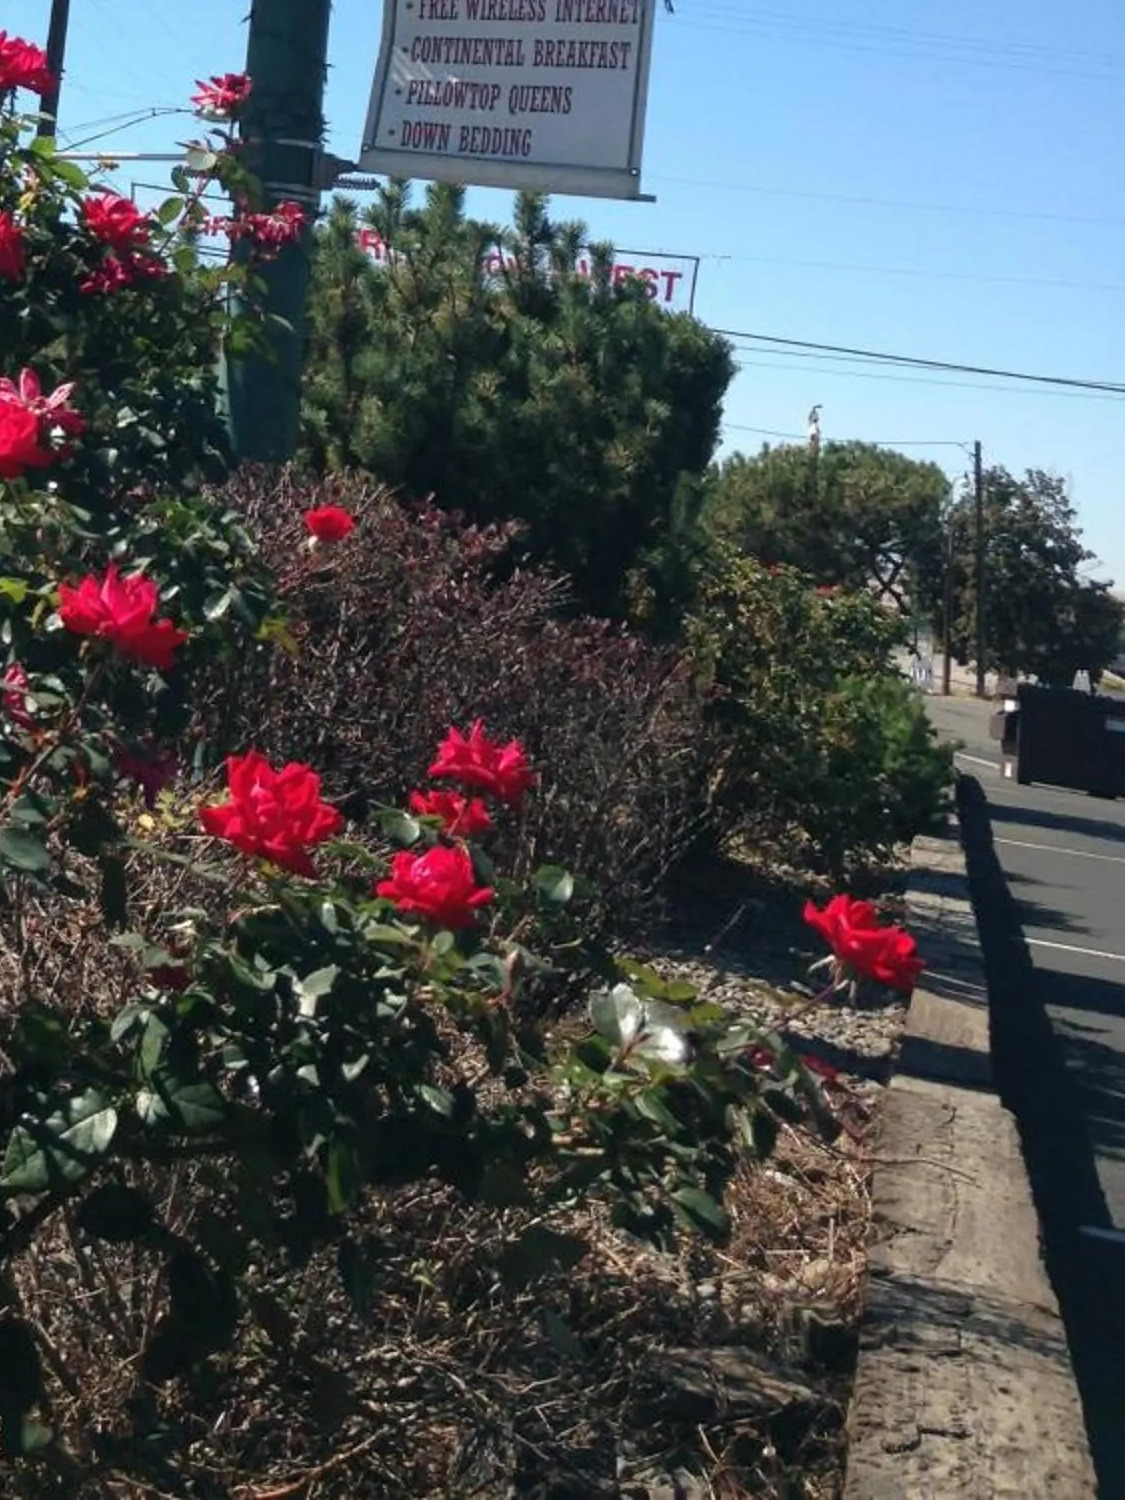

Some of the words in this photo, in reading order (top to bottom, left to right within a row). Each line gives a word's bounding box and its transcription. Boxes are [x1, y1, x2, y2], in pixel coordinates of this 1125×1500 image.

[410, 35, 525, 67] CONTINENTAL
[532, 38, 632, 71] BREAKFAST
[404, 78, 503, 112] PILLOWTOP
[508, 84, 573, 116] QUEENS
[400, 119, 451, 150] DOWN
[458, 125, 533, 157] BEDDING
